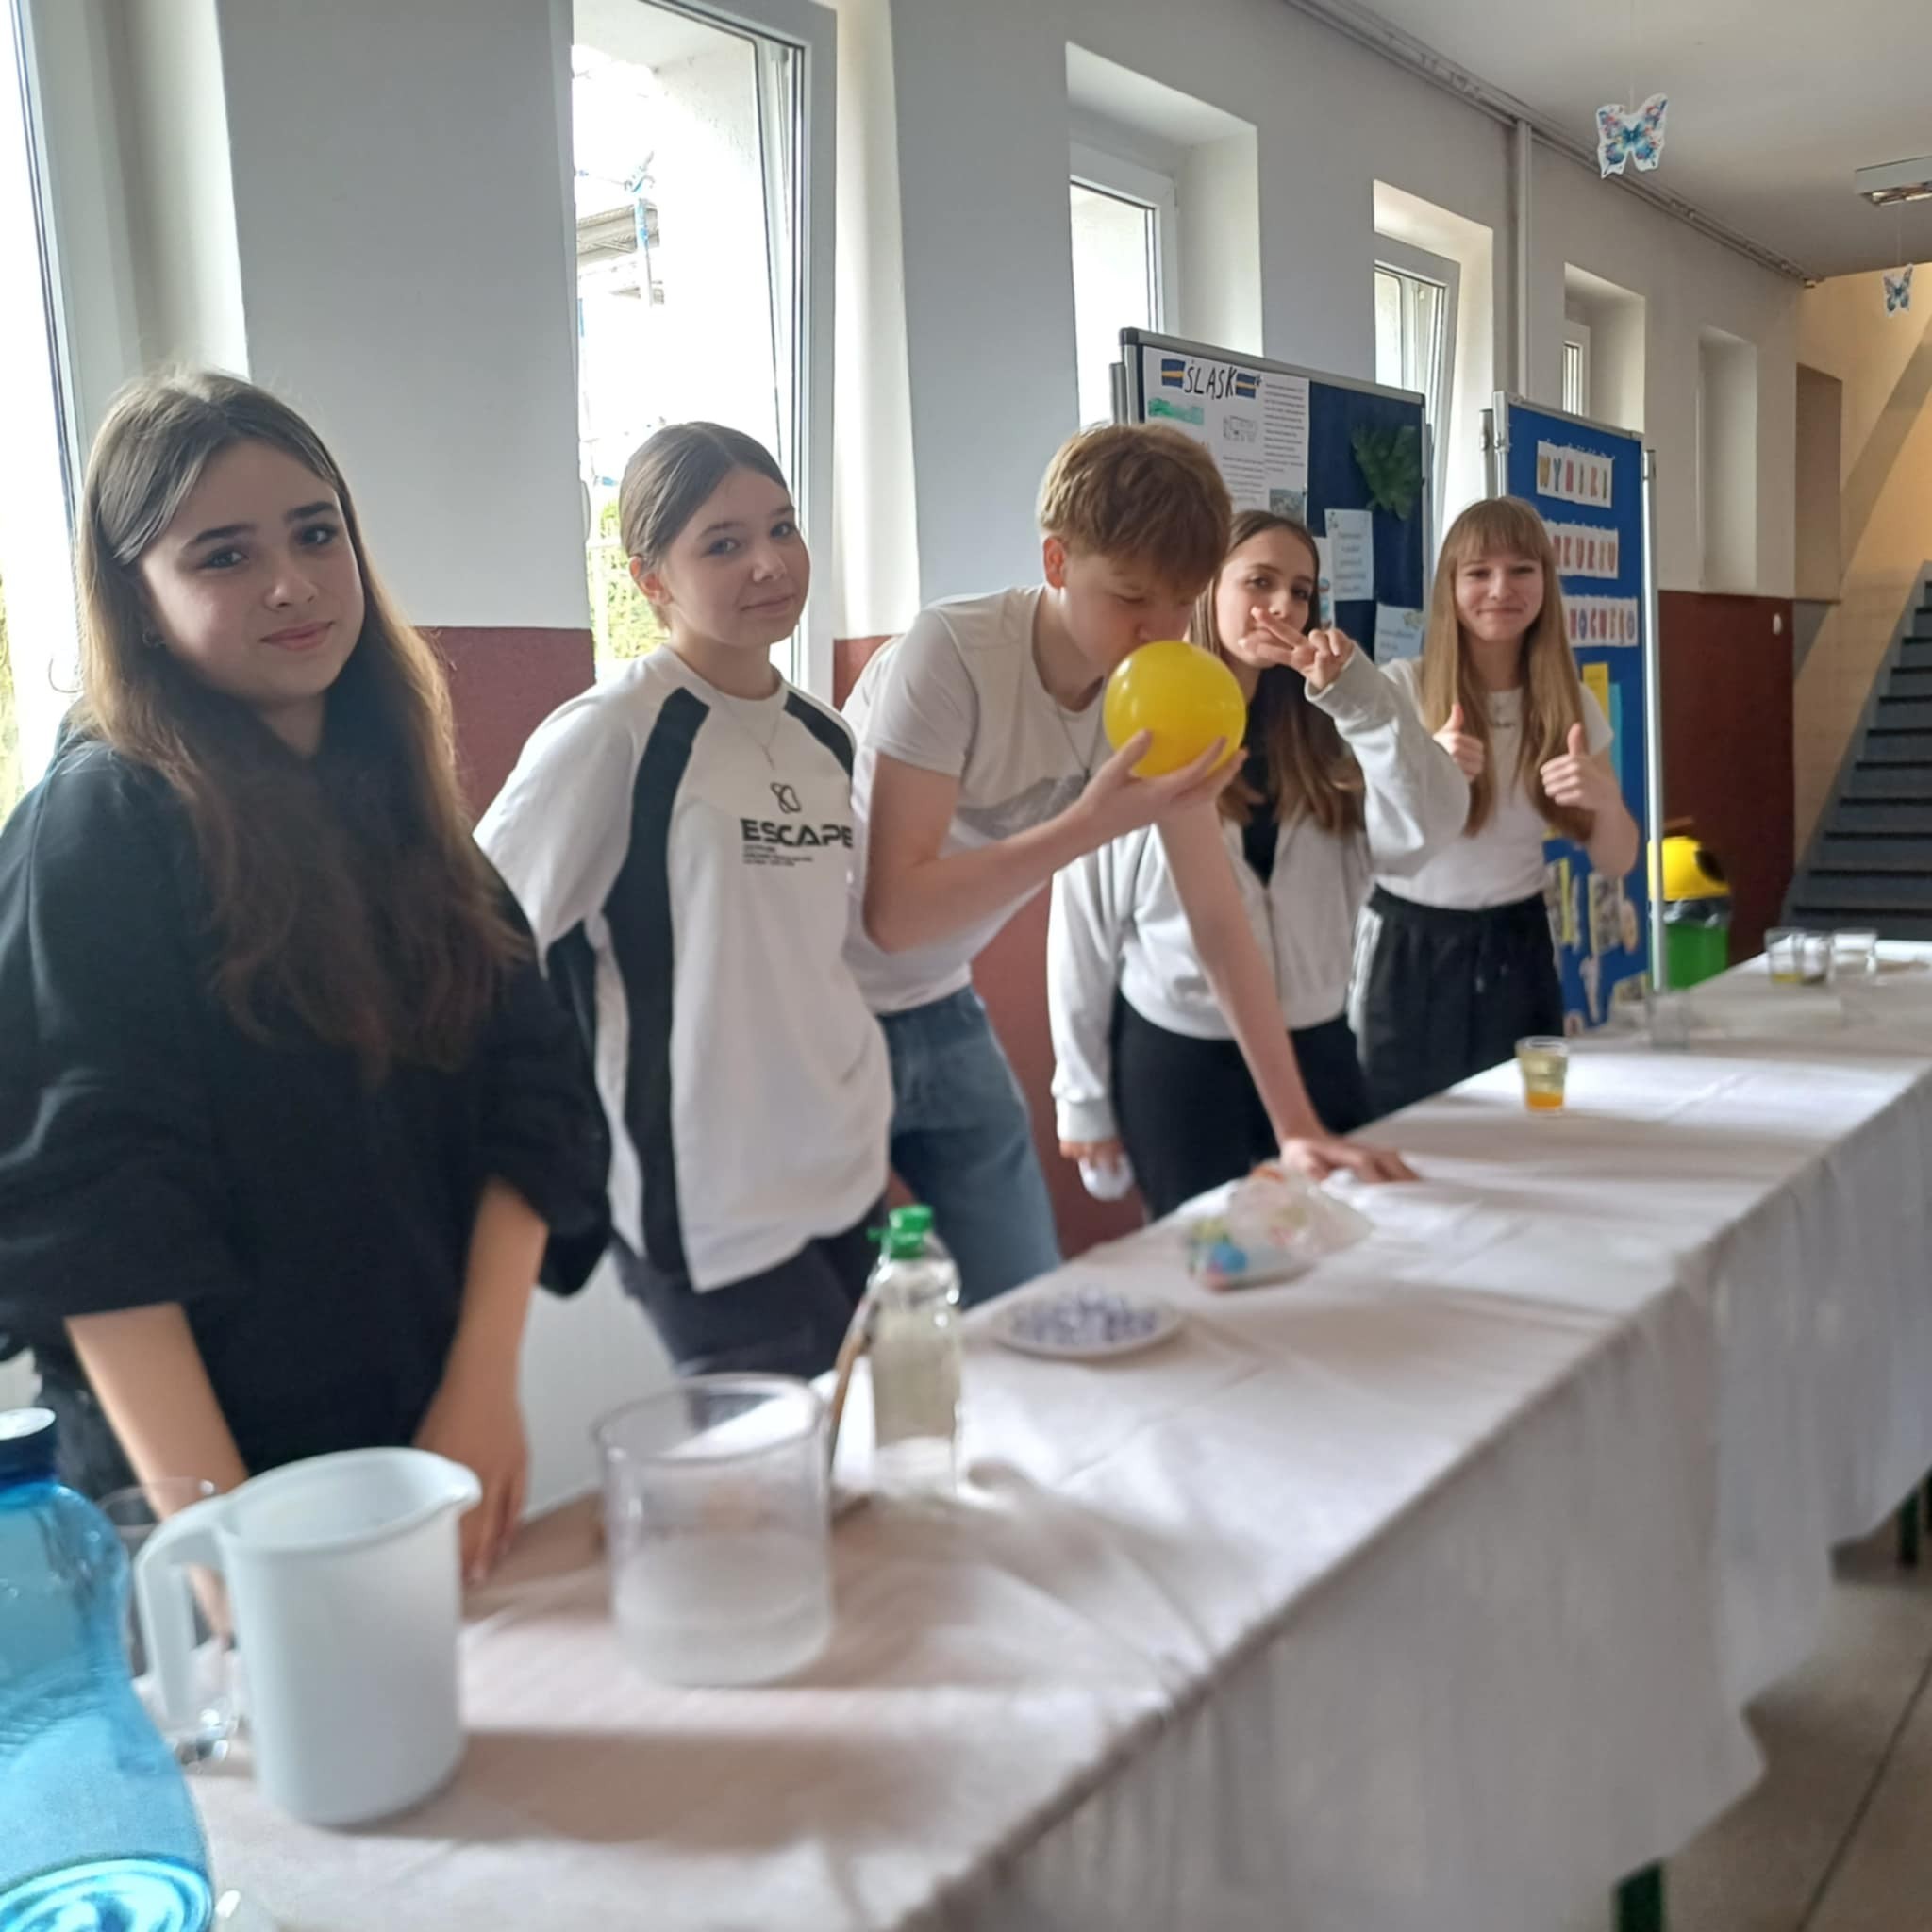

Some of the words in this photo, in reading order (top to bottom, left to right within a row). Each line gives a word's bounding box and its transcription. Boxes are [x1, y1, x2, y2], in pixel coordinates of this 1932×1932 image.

[1539, 455, 1607, 499] WYNIKI
[1570, 607, 1636, 645] NOCNEGO
[741, 818, 853, 848] ESCAPE
